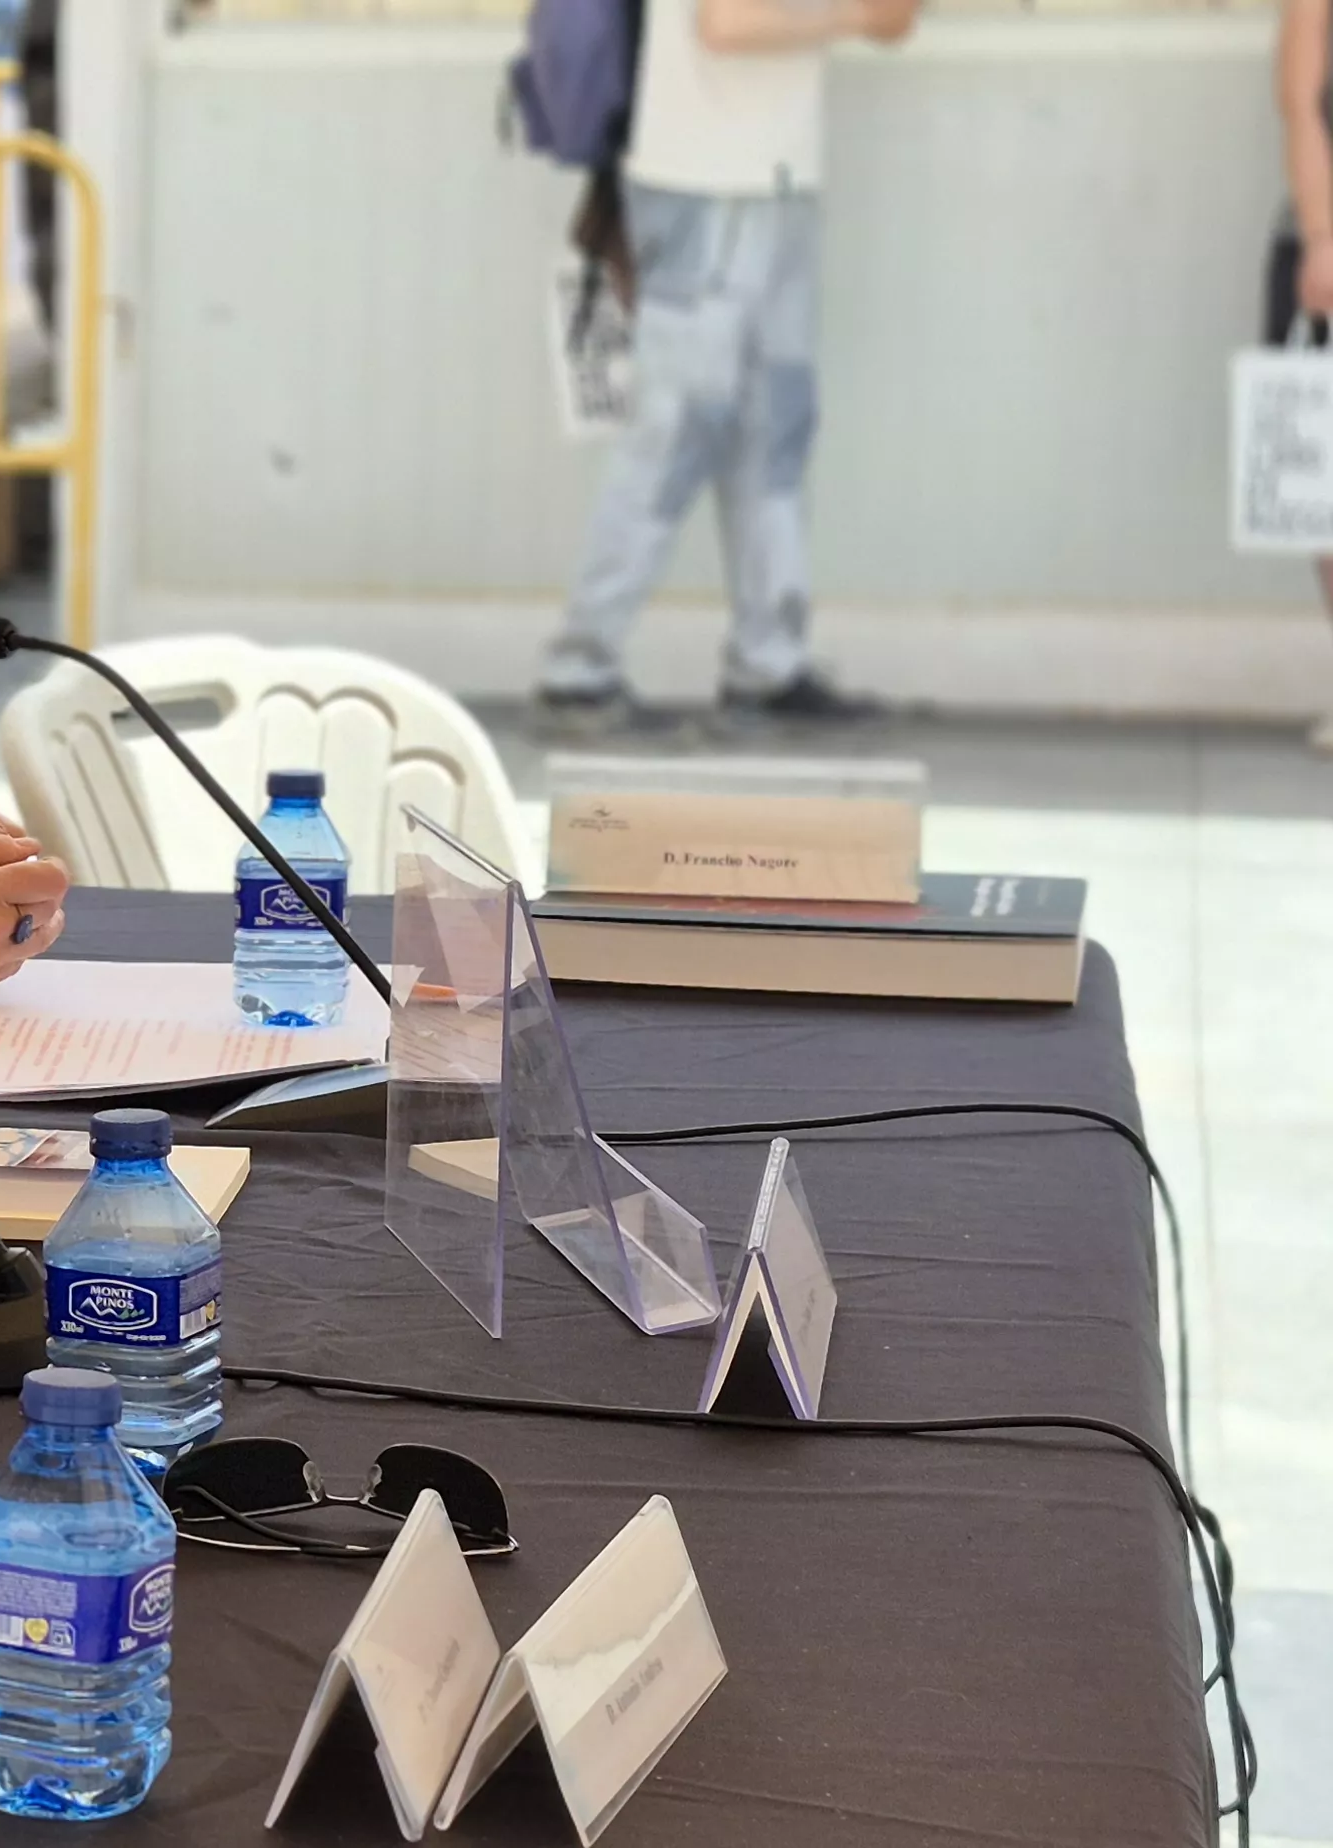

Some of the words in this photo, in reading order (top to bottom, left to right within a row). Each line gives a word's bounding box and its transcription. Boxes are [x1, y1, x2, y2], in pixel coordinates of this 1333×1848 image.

[663, 851, 680, 866] D.
[683, 852, 744, 867] Francho
[747, 854, 799, 870] Nagore
[90, 1285, 135, 1299] MONTE
[95, 1295, 135, 1310] PINOS
